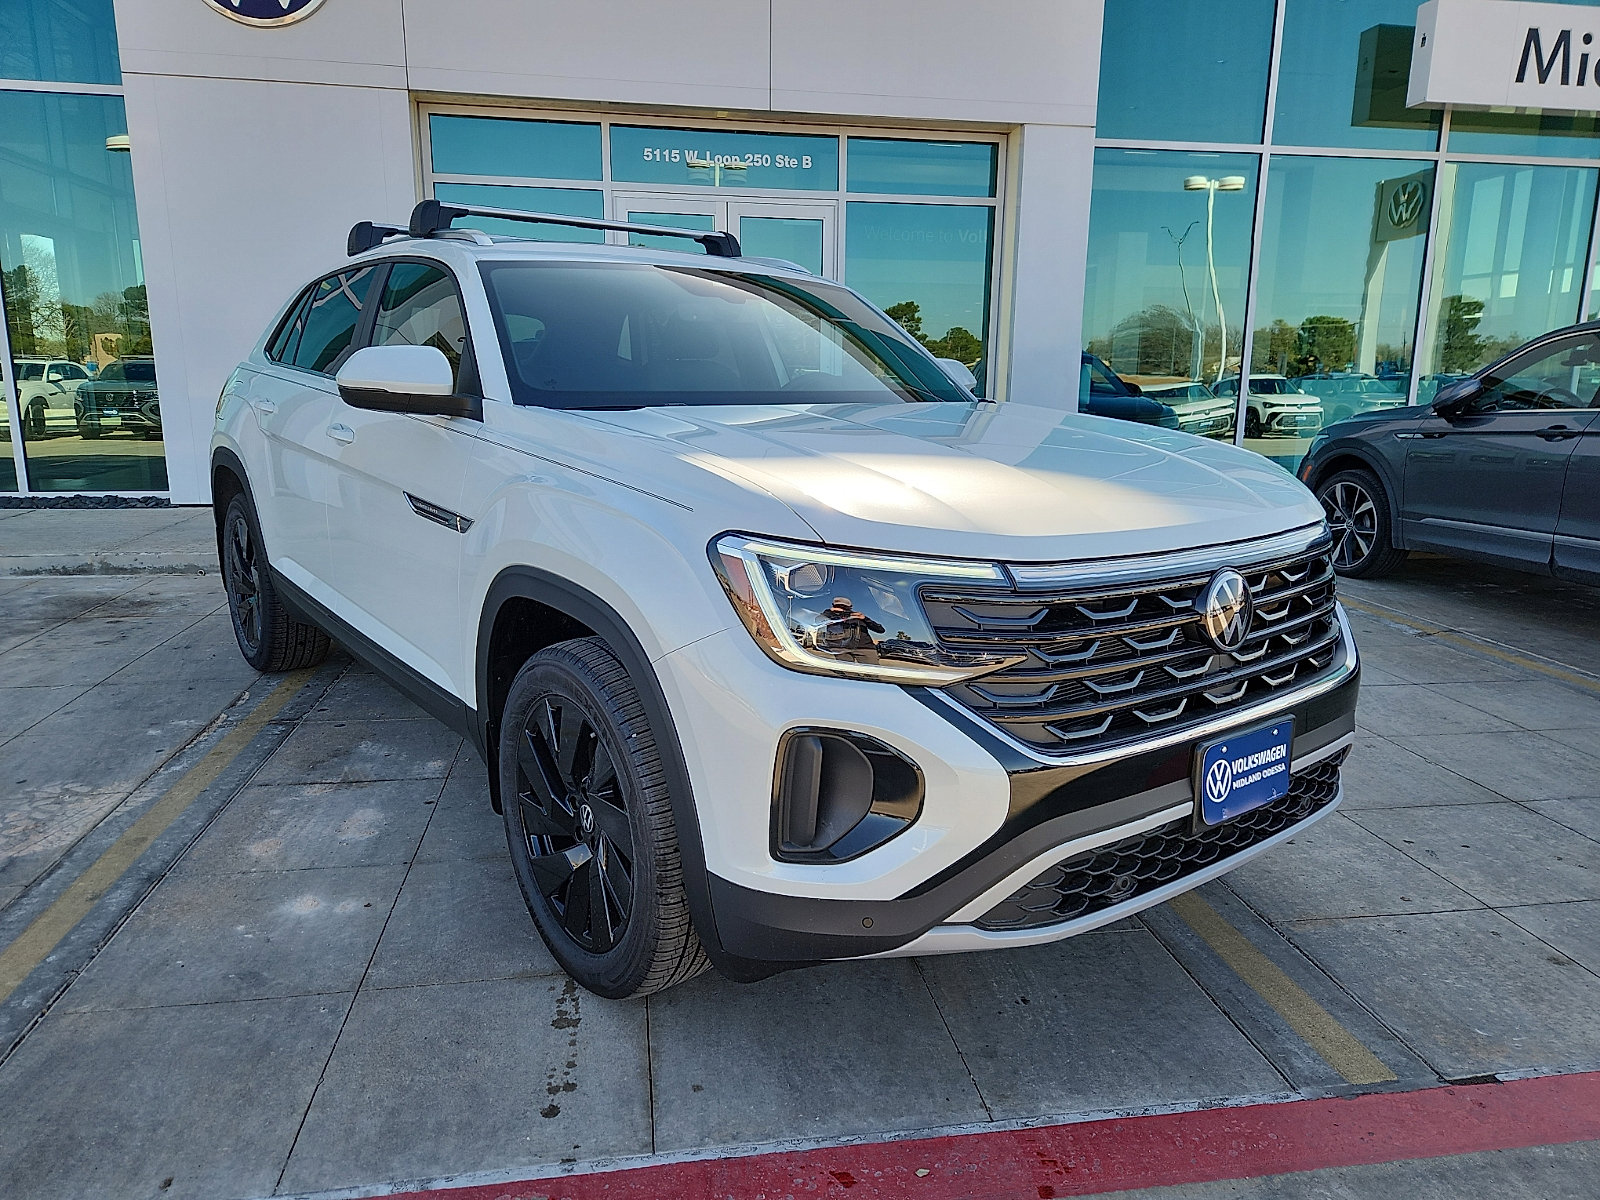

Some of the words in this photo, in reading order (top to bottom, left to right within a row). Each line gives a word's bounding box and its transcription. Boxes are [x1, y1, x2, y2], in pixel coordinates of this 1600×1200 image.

[1515, 27, 1600, 88] Mi
[643, 148, 680, 163] 5115
[706, 151, 740, 167] Loop
[744, 153, 771, 167] 250
[775, 155, 798, 169] Ste
[802, 155, 813, 169] B
[864, 225, 936, 241] Welcome
[1231, 743, 1287, 775] VOLKSWAGEN
[1232, 770, 1262, 791] MIDLAND
[1262, 763, 1287, 779] ODESSA
